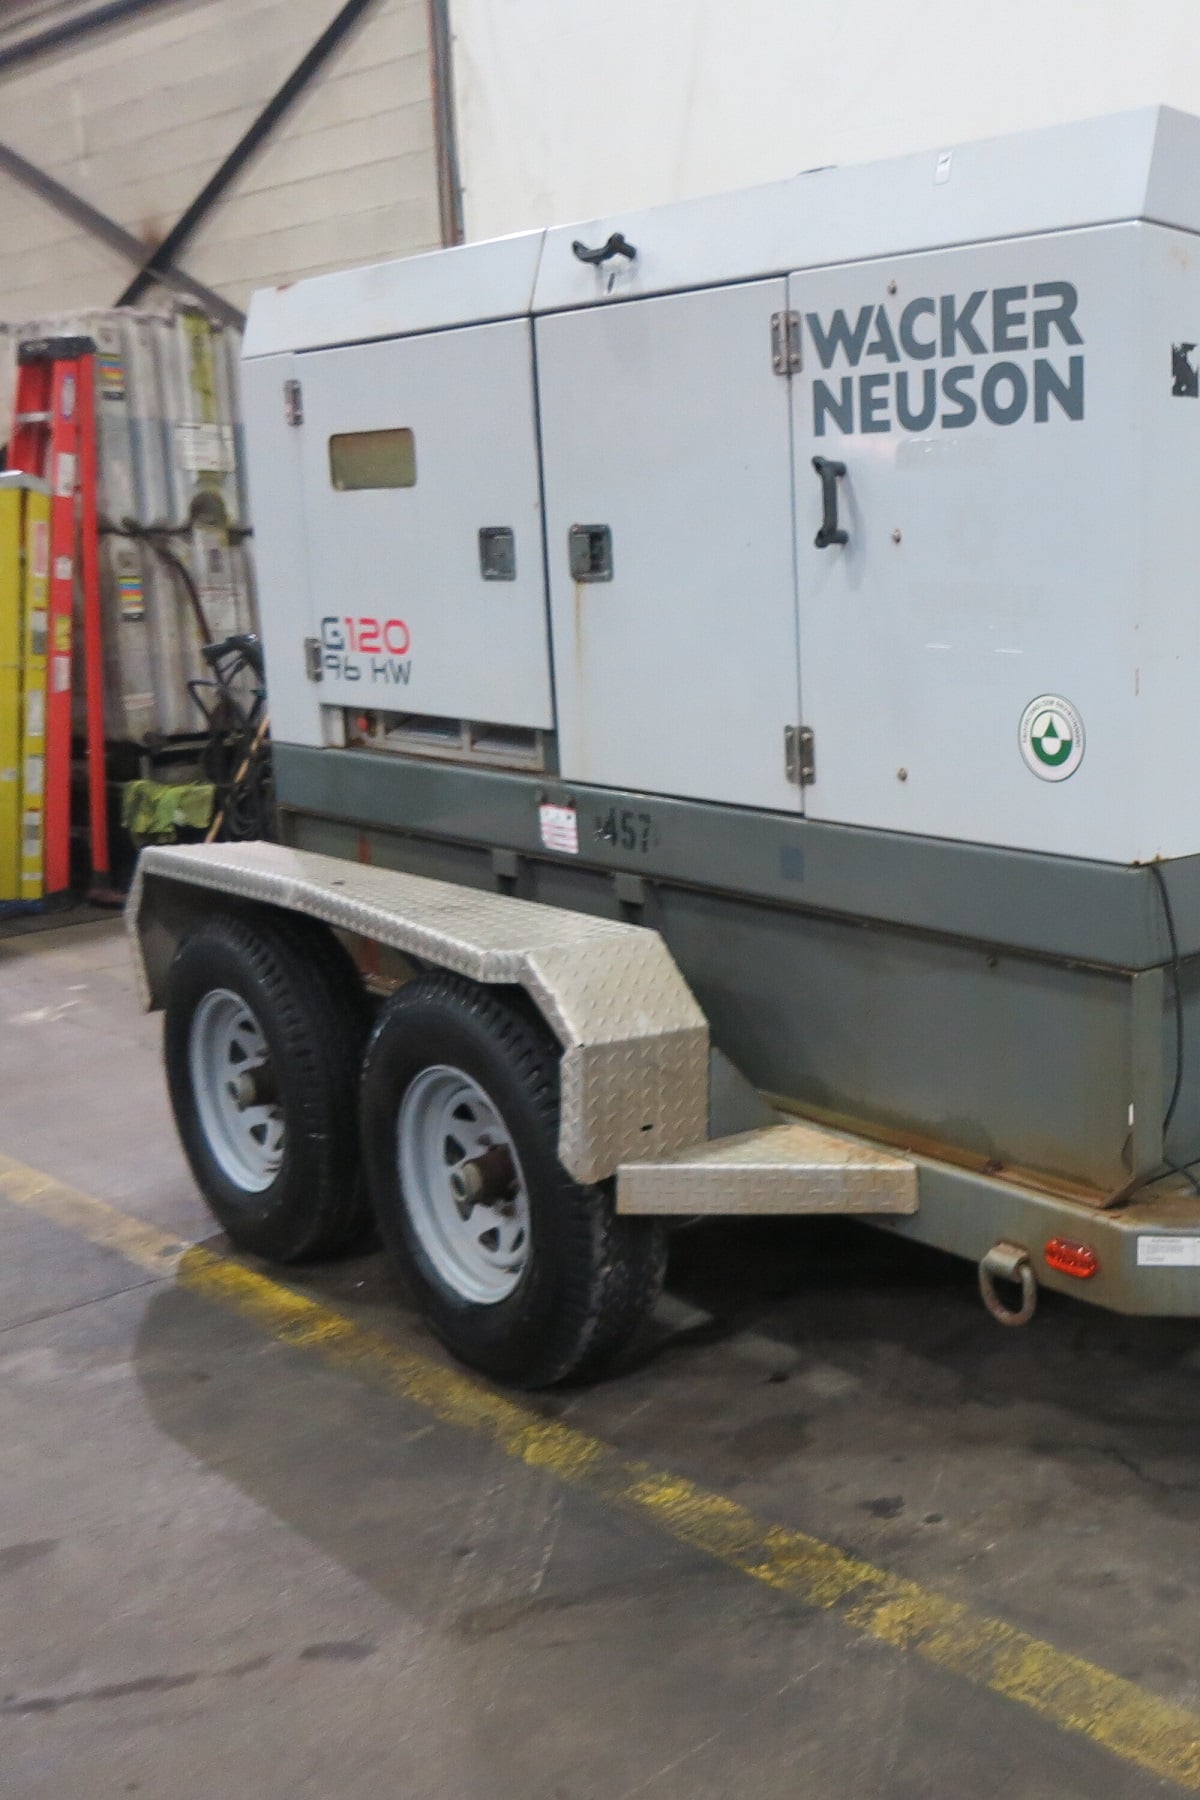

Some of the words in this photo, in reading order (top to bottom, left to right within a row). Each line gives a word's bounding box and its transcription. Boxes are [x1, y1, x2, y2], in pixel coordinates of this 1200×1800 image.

[805, 280, 1084, 370] WACKER
[811, 354, 1085, 437] NEUSON
[321, 616, 411, 656] G120
[602, 807, 652, 853] 457
